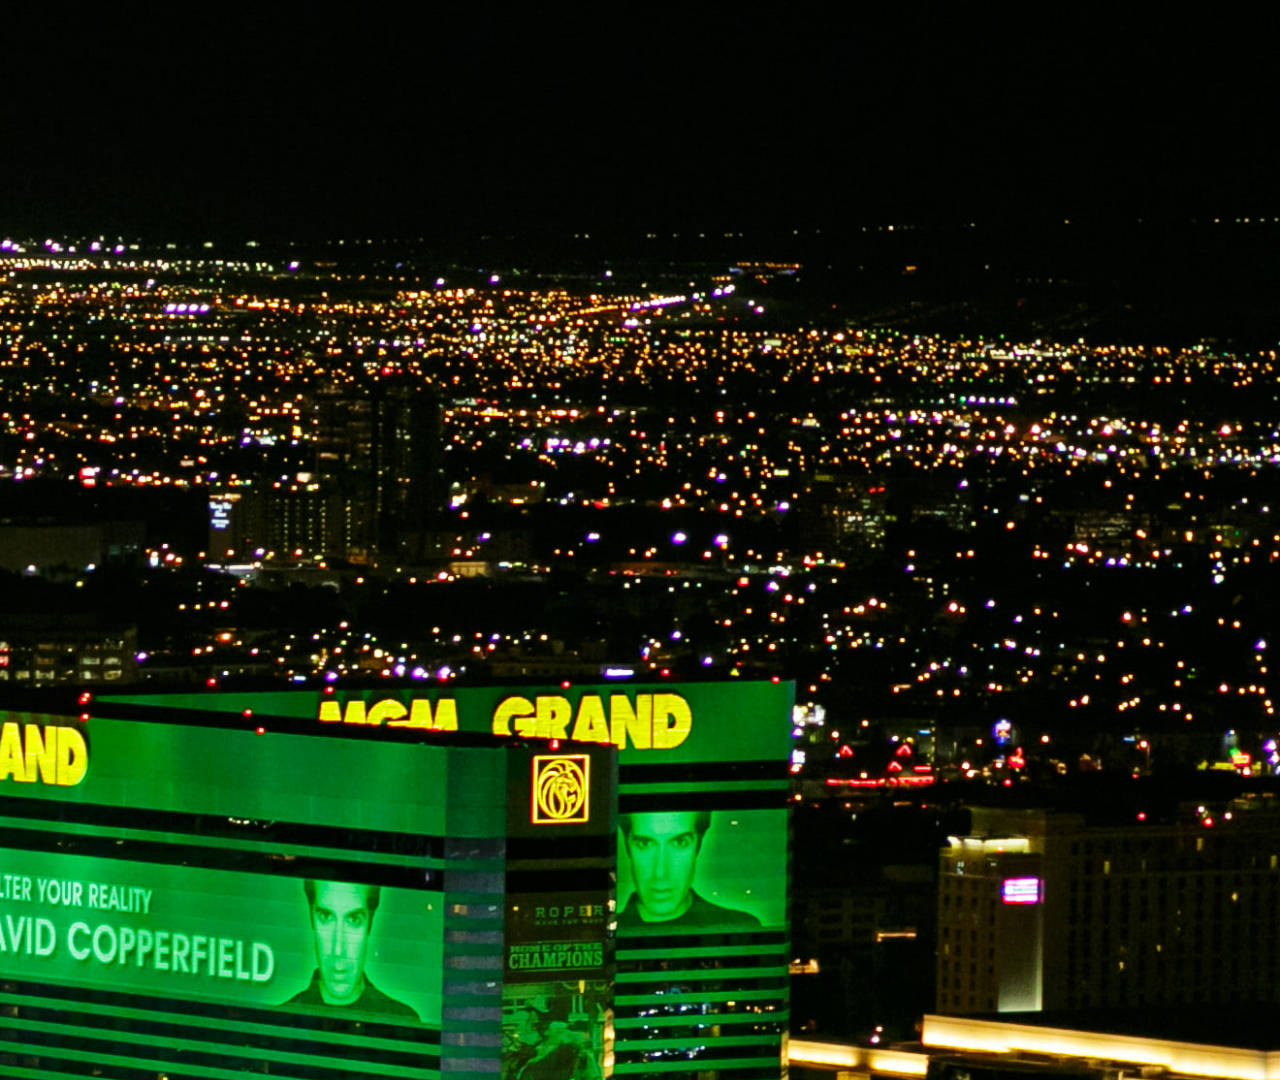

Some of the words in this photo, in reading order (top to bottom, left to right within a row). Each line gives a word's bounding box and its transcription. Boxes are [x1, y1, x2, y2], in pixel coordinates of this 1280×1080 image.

[492, 693, 692, 750] GRAND
[37, 879, 82, 907] YOUR
[88, 884, 153, 914] REALITY
[67, 921, 275, 983] COPPERFIELD
[509, 951, 603, 969] CHAMPIONS
